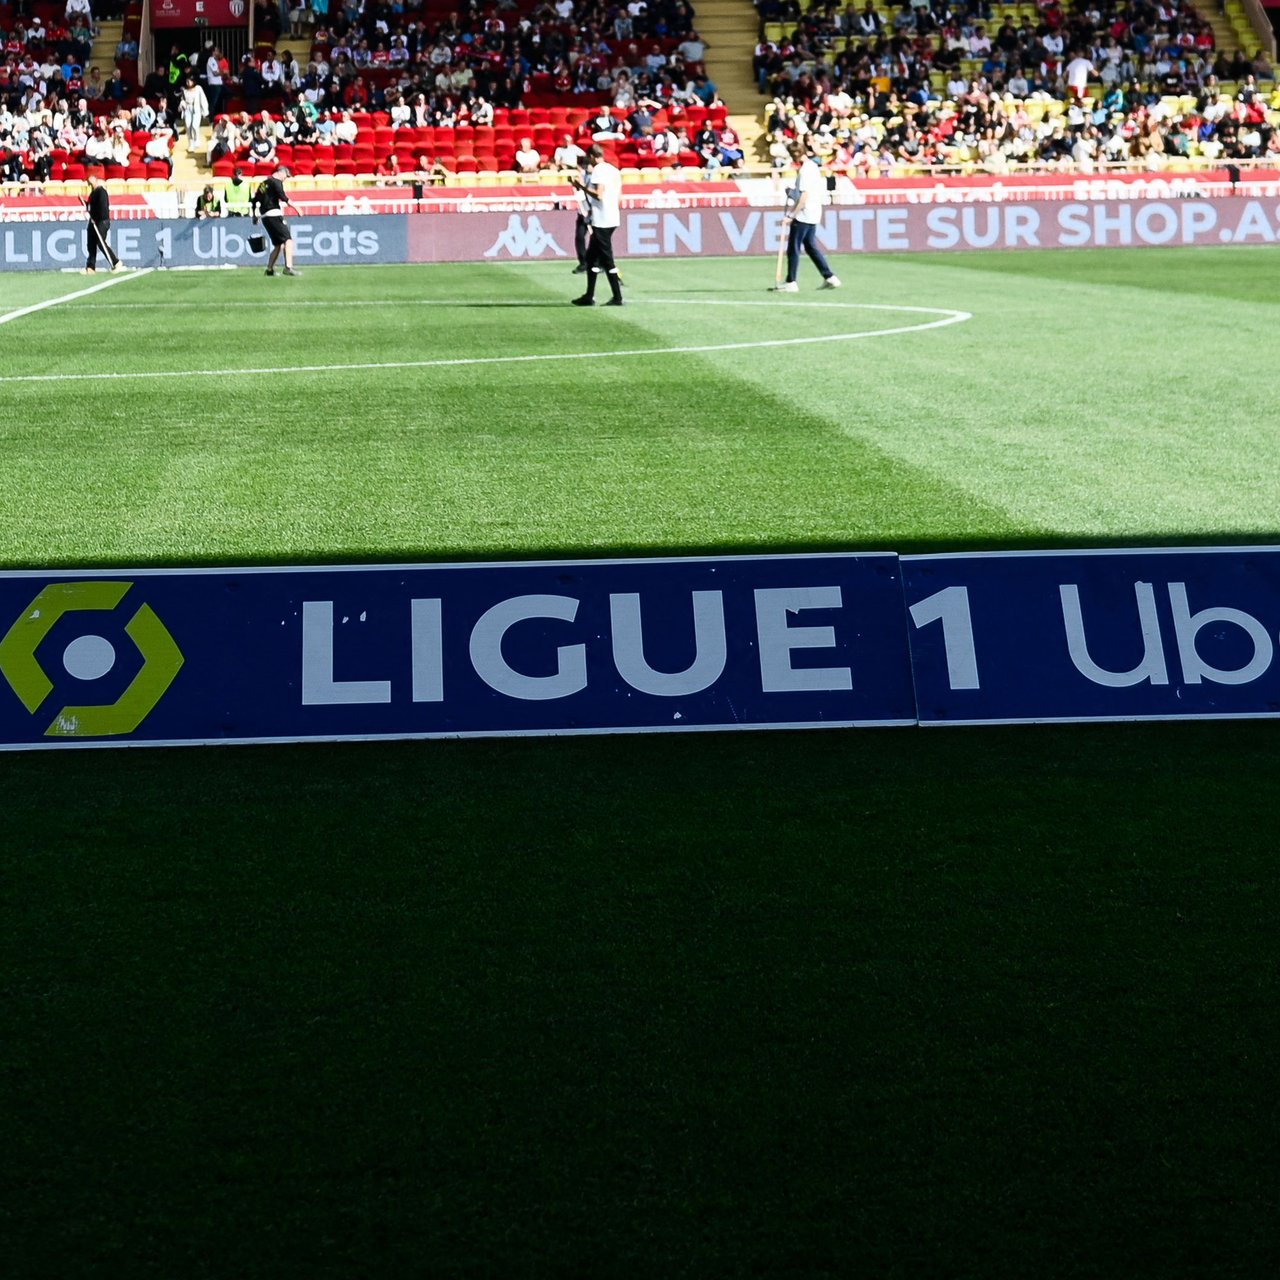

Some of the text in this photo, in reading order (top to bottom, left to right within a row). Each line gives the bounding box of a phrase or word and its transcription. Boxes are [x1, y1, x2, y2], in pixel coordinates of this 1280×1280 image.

[155, 226, 173, 259] 1
[289, 224, 380, 257] Eats
[626, 212, 702, 255] EN
[926, 205, 1041, 250] SUR
[301, 585, 853, 707] LIGUE
[908, 585, 981, 691] 1
